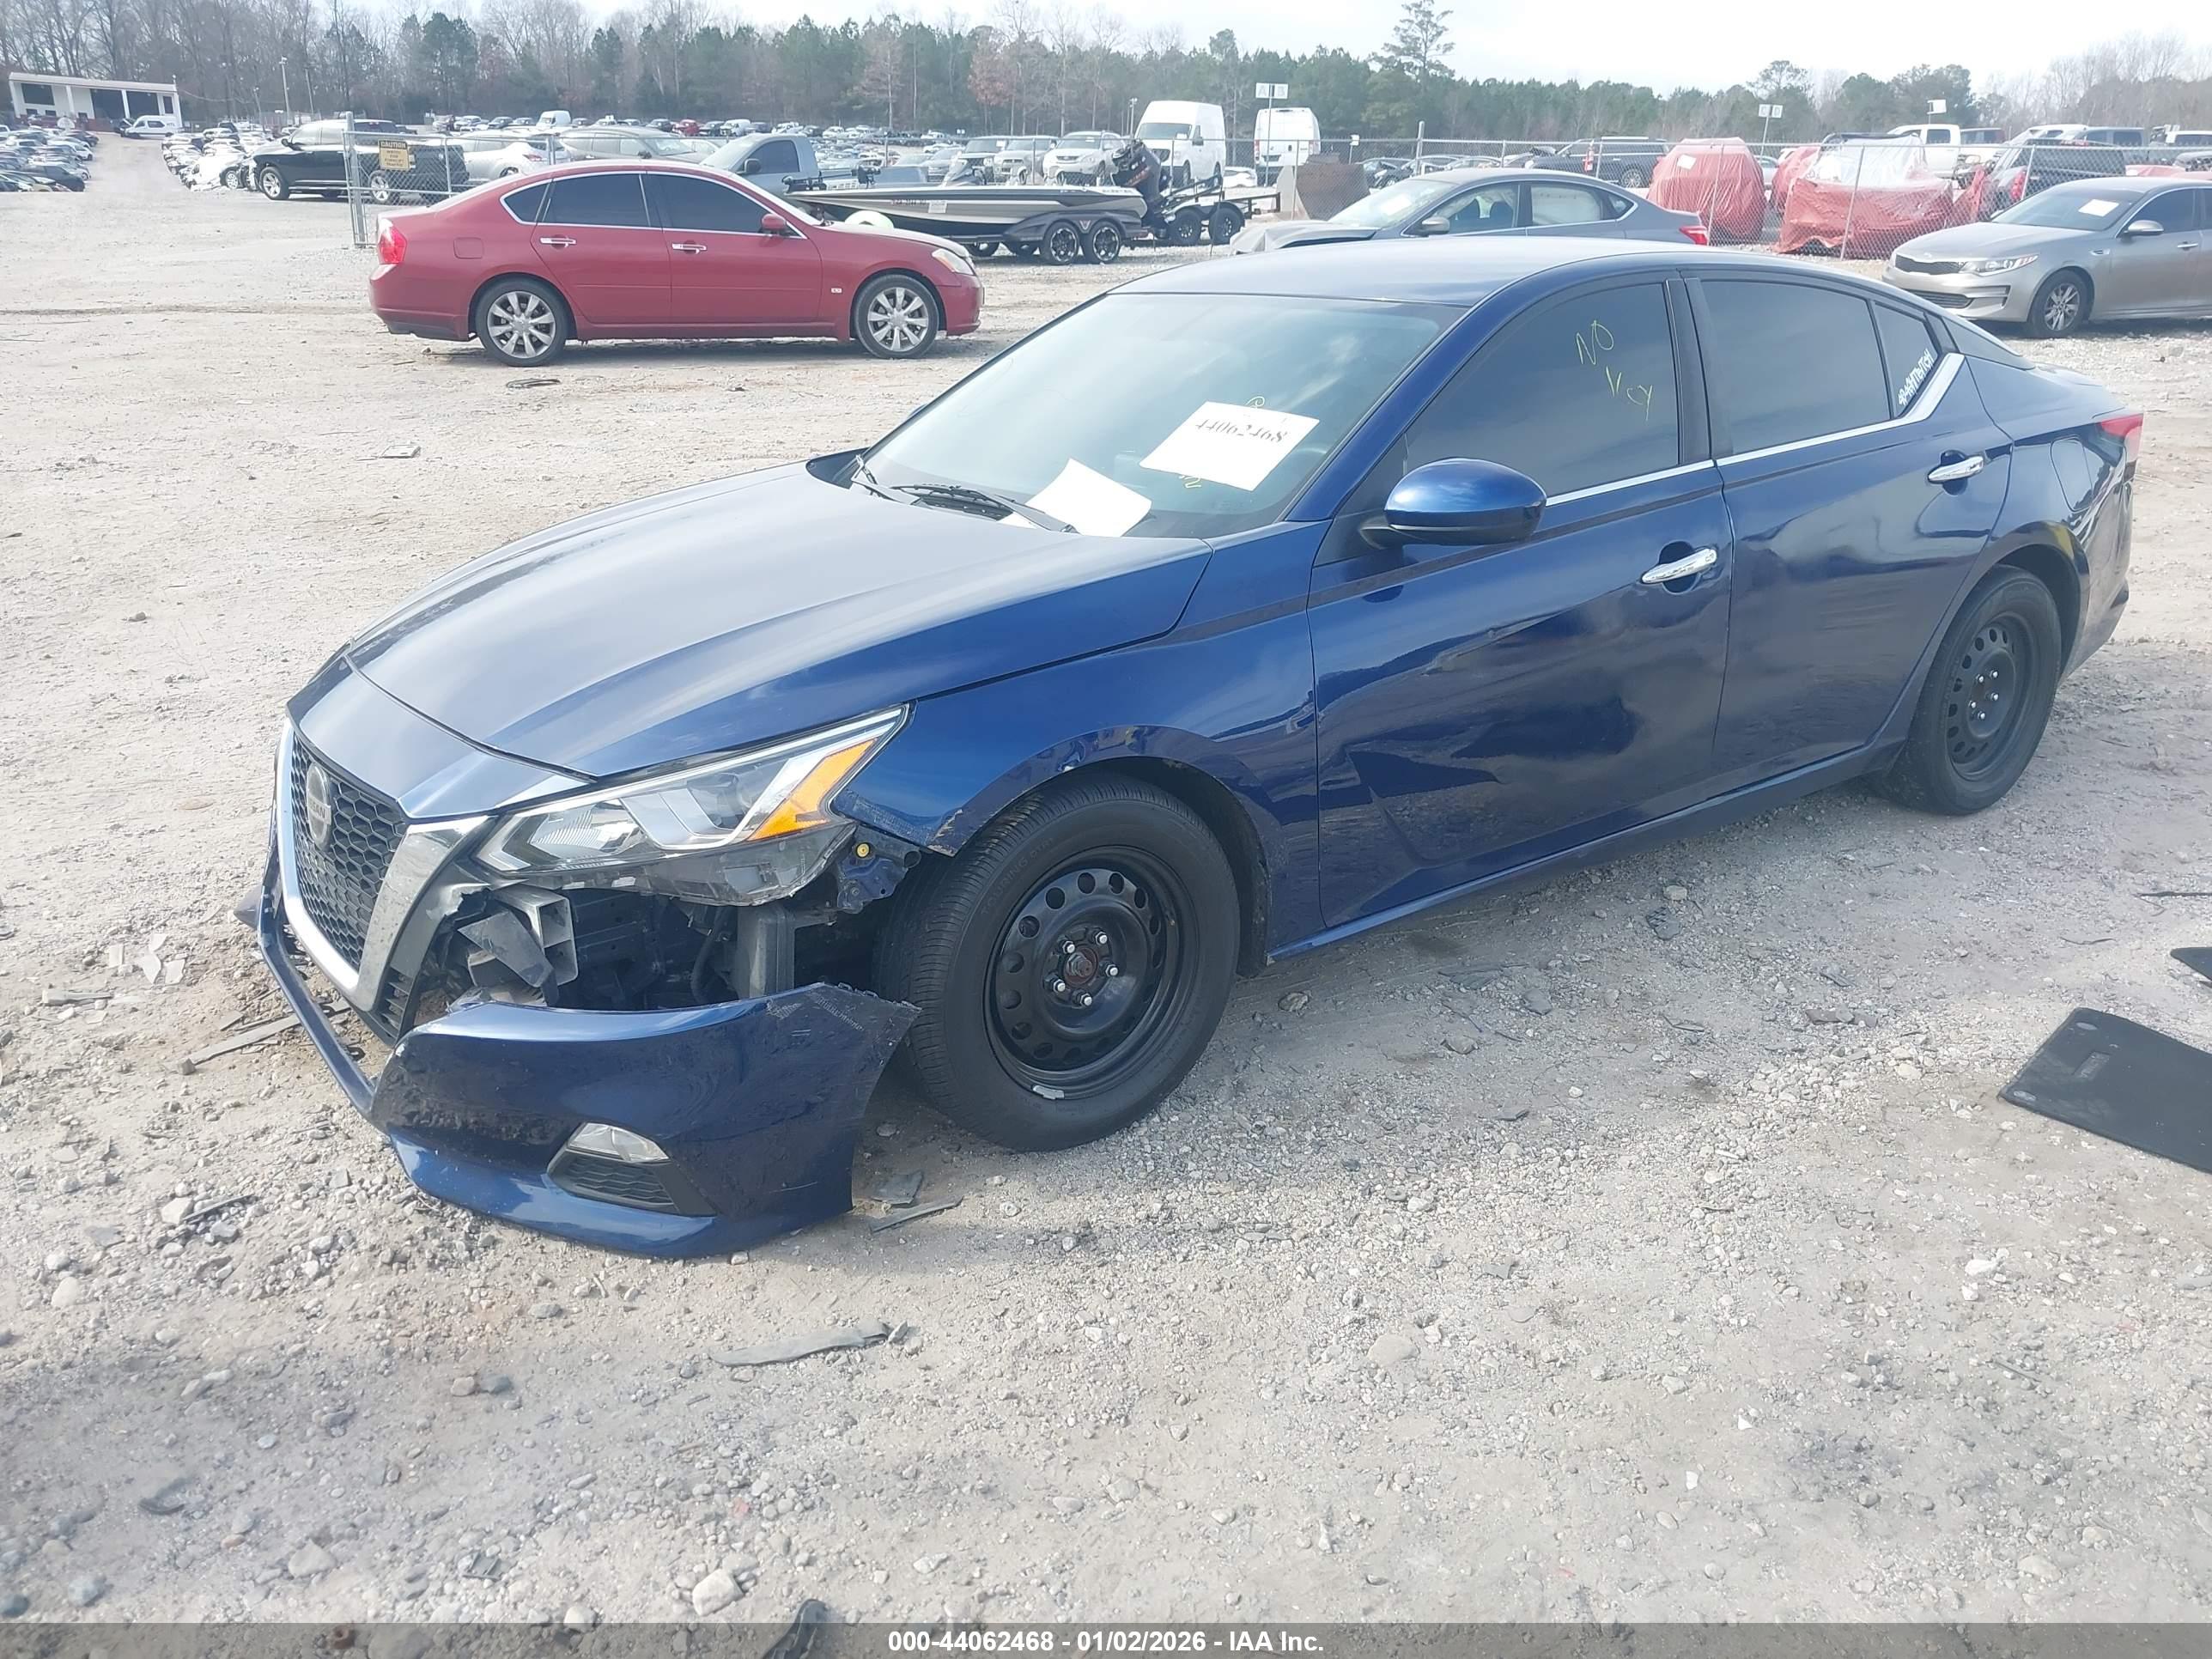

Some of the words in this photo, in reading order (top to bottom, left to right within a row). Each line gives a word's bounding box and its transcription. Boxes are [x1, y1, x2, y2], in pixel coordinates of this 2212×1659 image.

[1258, 85, 1267, 97] A
[1576, 319, 1614, 366] NO
[1195, 418, 1288, 442] 44062468
